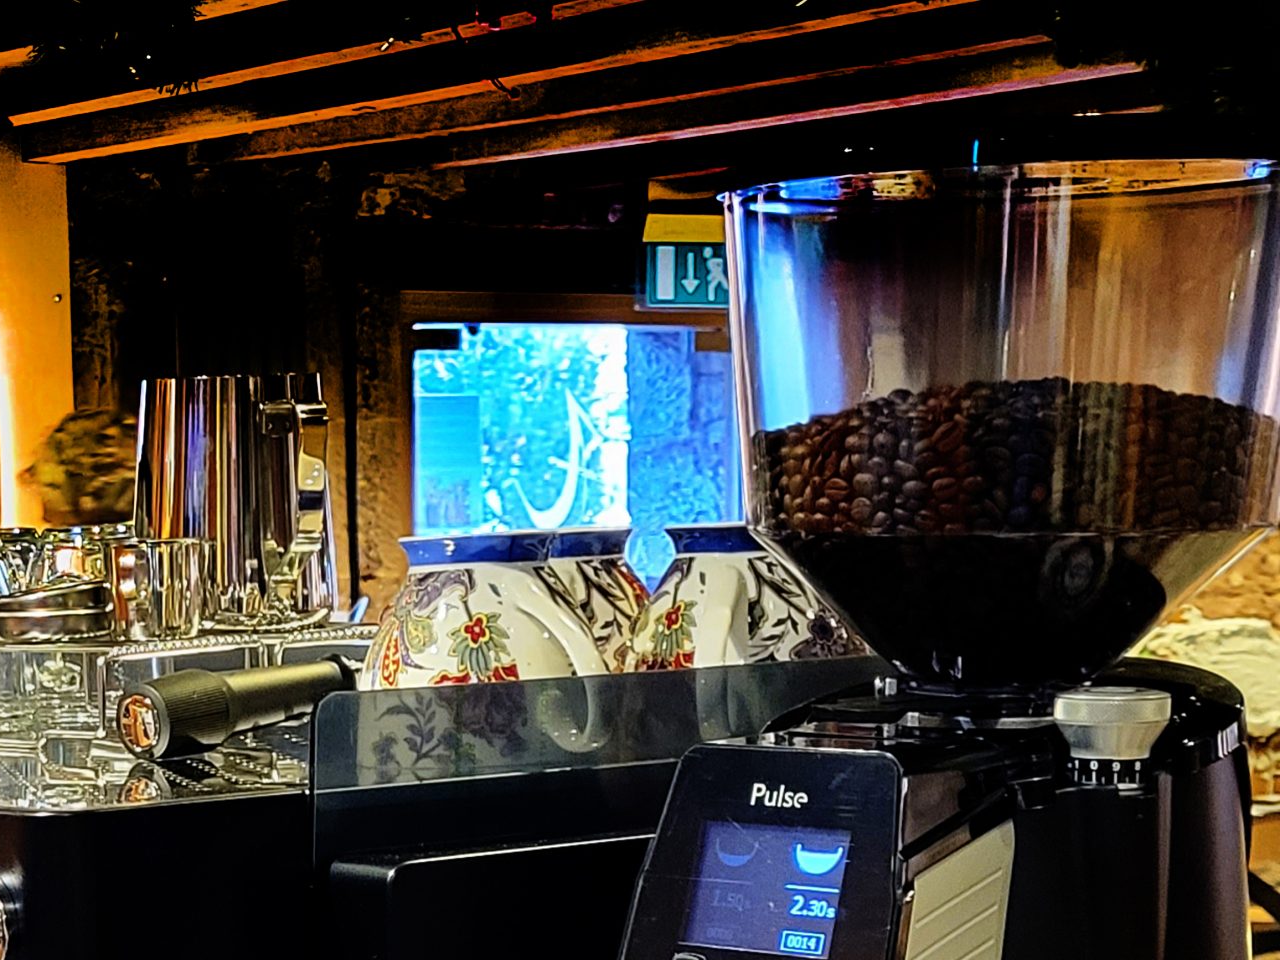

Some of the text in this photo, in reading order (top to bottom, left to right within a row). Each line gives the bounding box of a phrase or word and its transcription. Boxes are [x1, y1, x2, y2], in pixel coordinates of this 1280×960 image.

[749, 782, 809, 809] Pulse
[789, 894, 837, 919] 2.30s
[786, 934, 818, 950] 0014
